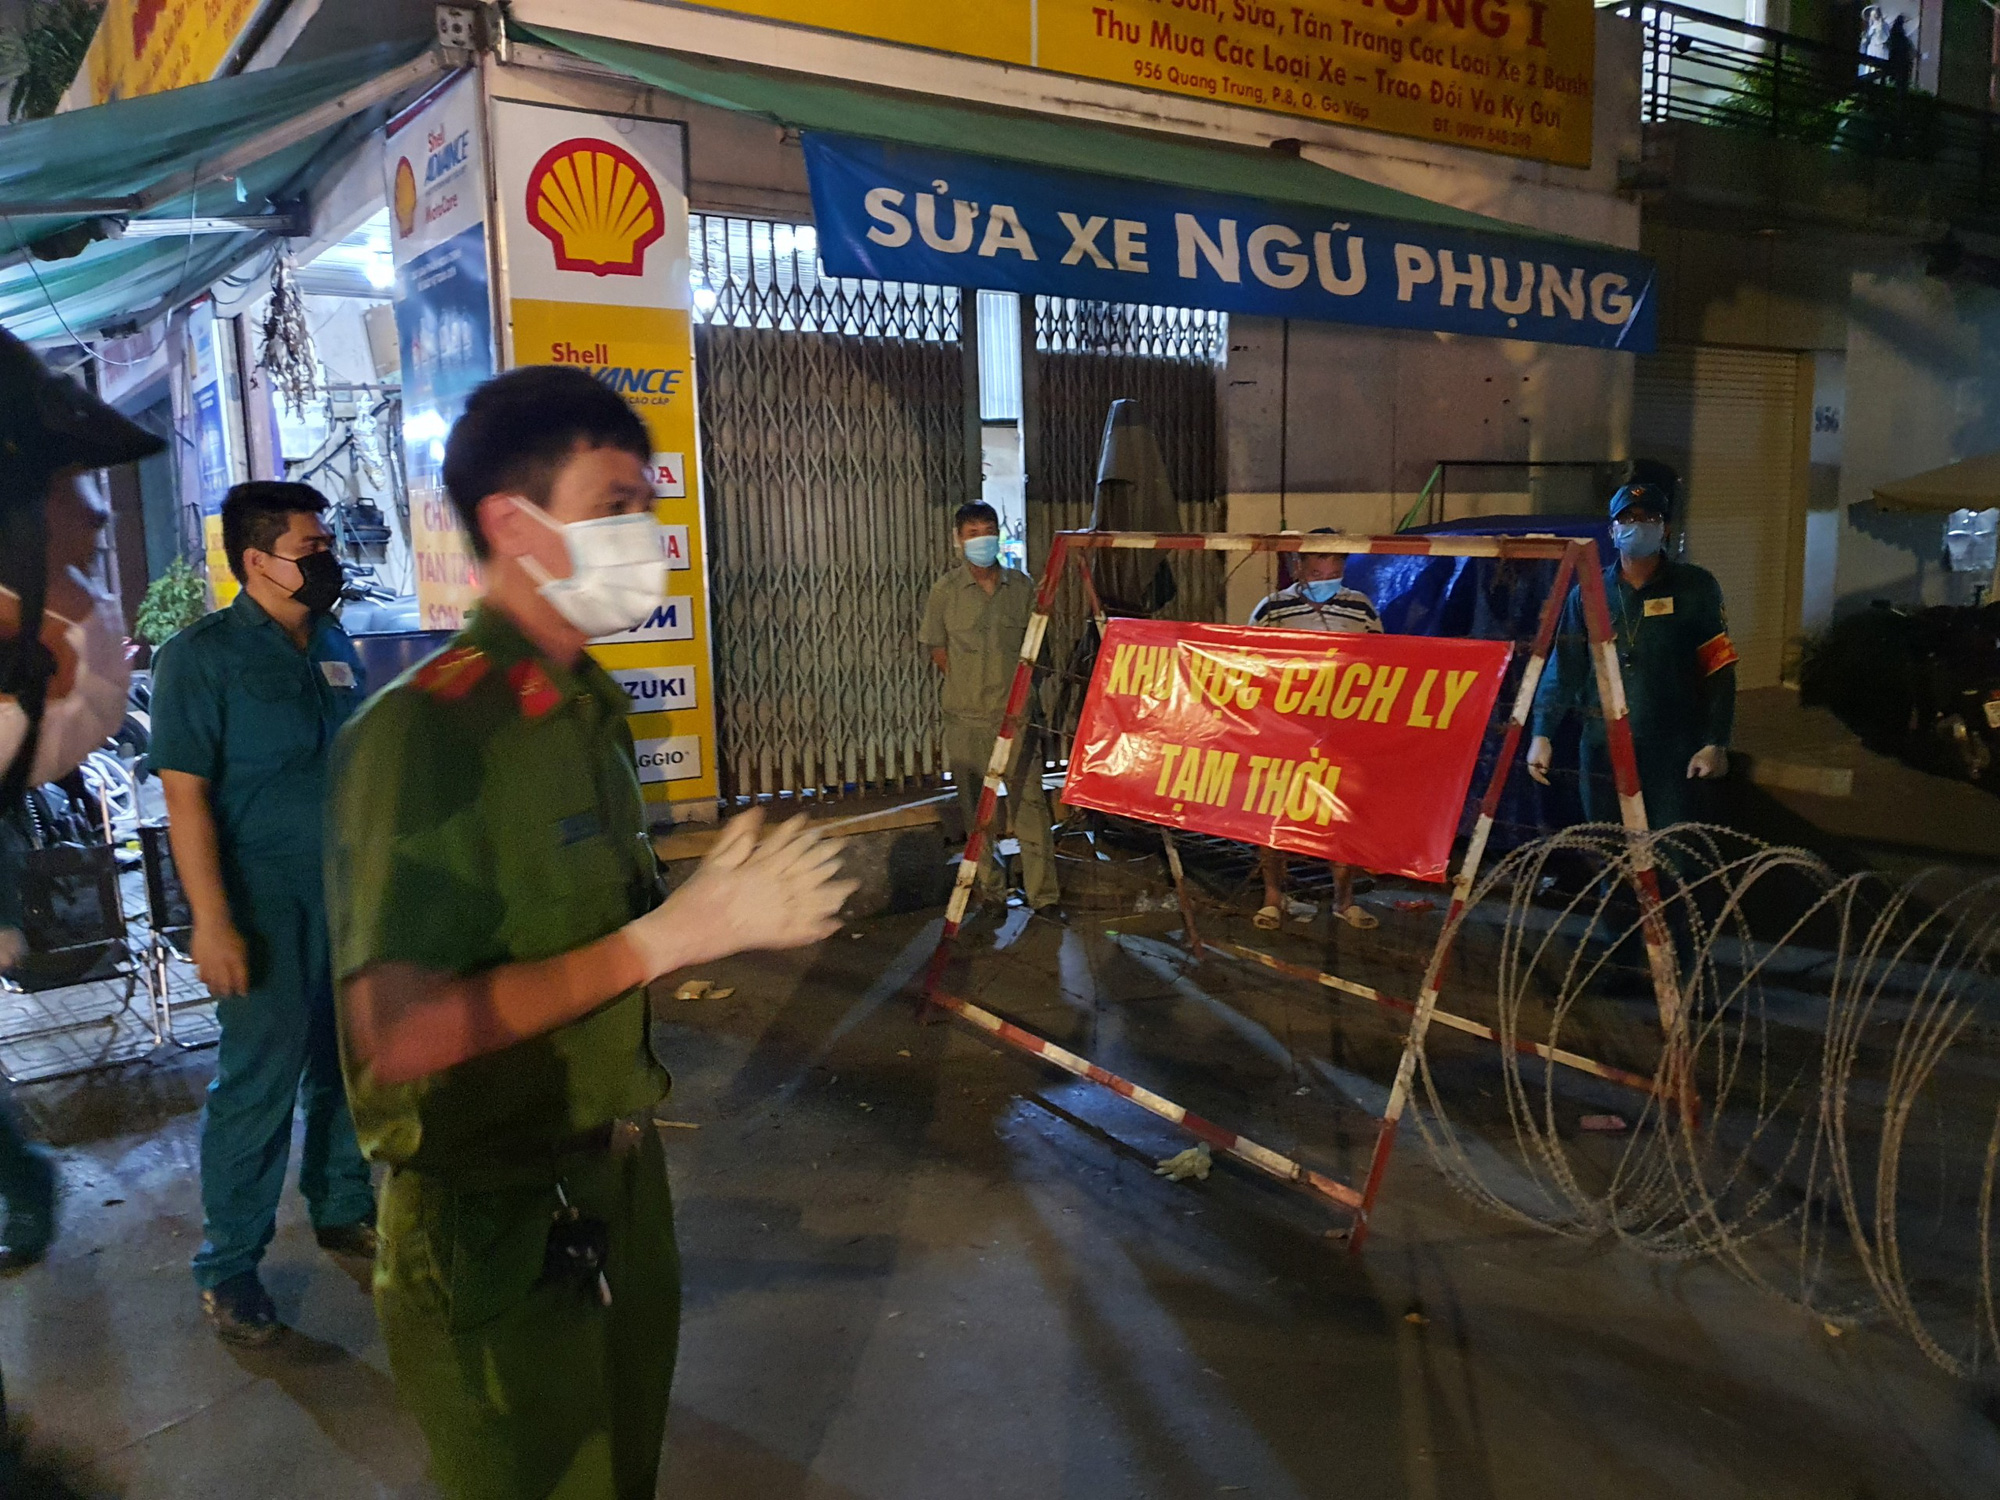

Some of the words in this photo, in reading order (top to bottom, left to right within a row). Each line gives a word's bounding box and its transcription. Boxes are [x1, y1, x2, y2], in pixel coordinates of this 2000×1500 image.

[1092, 7, 1140, 44] Thu
[1150, 20, 1205, 57] Mua
[1317, 55, 1347, 87] Xe
[1375, 68, 1422, 101] Trao
[1134, 59, 1163, 81] 956
[1167, 66, 1217, 95] Quang
[1341, 19, 1403, 63] Trang
[1496, 55, 1520, 83] Xe
[1525, 62, 1538, 86] 2
[864, 179, 1039, 261] SỬA
[1057, 211, 1149, 274] XE
[1174, 212, 1367, 297] NGŨ
[1394, 242, 1633, 329] PHỤNG
[551, 341, 609, 365] Shell
[622, 677, 687, 700] ZUKI
[1105, 643, 1181, 702] KHU
[1273, 647, 1407, 724] CÁCH
[1406, 668, 1479, 730] LY
[636, 751, 684, 768] GGIO
[1155, 743, 1240, 814] TẠM
